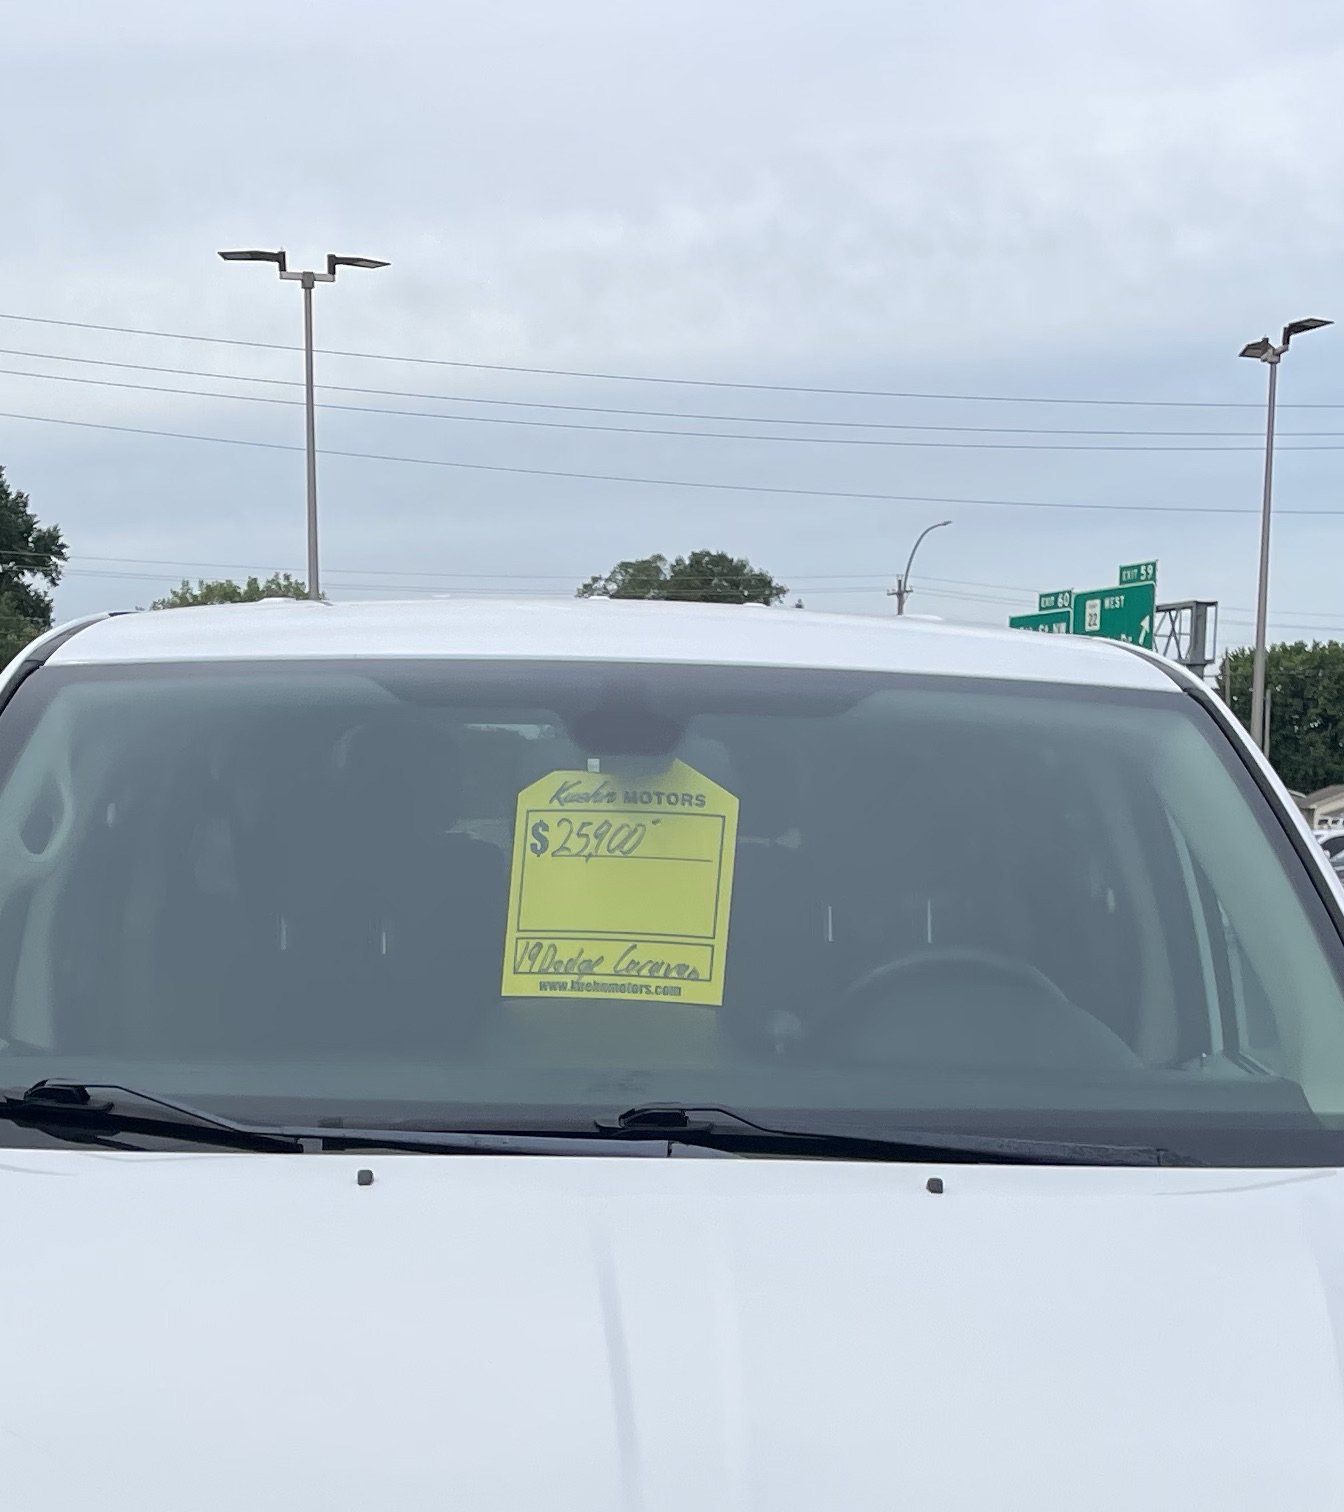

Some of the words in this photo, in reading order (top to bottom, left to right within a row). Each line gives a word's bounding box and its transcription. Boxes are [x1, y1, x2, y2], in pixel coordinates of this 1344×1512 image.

[1140, 564, 1154, 580] 59
[1057, 592, 1070, 607] 60
[623, 790, 707, 808] MOTORS
